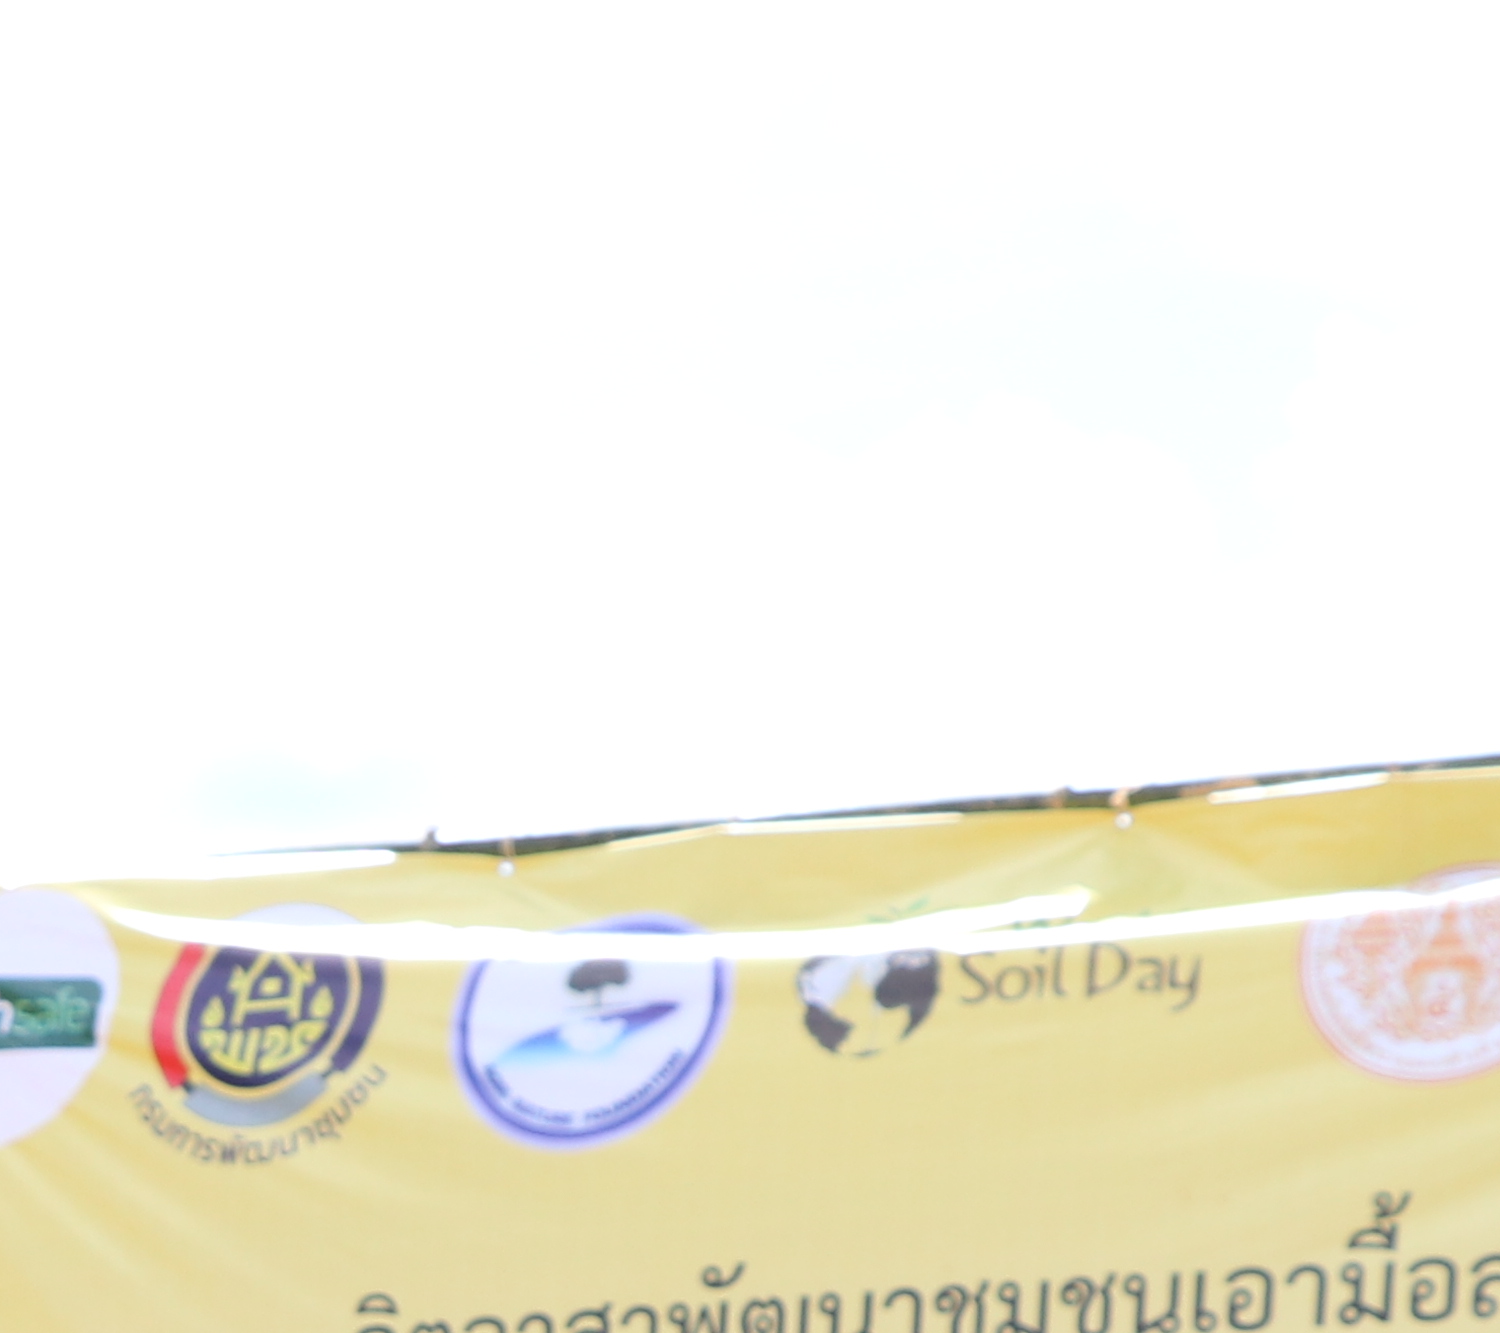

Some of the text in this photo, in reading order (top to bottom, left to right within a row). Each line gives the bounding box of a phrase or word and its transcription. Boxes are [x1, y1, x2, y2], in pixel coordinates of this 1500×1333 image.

[957, 941, 1204, 1013] Soil Day
[127, 1063, 388, 1165] กรมการพัฒนาชุมชน
